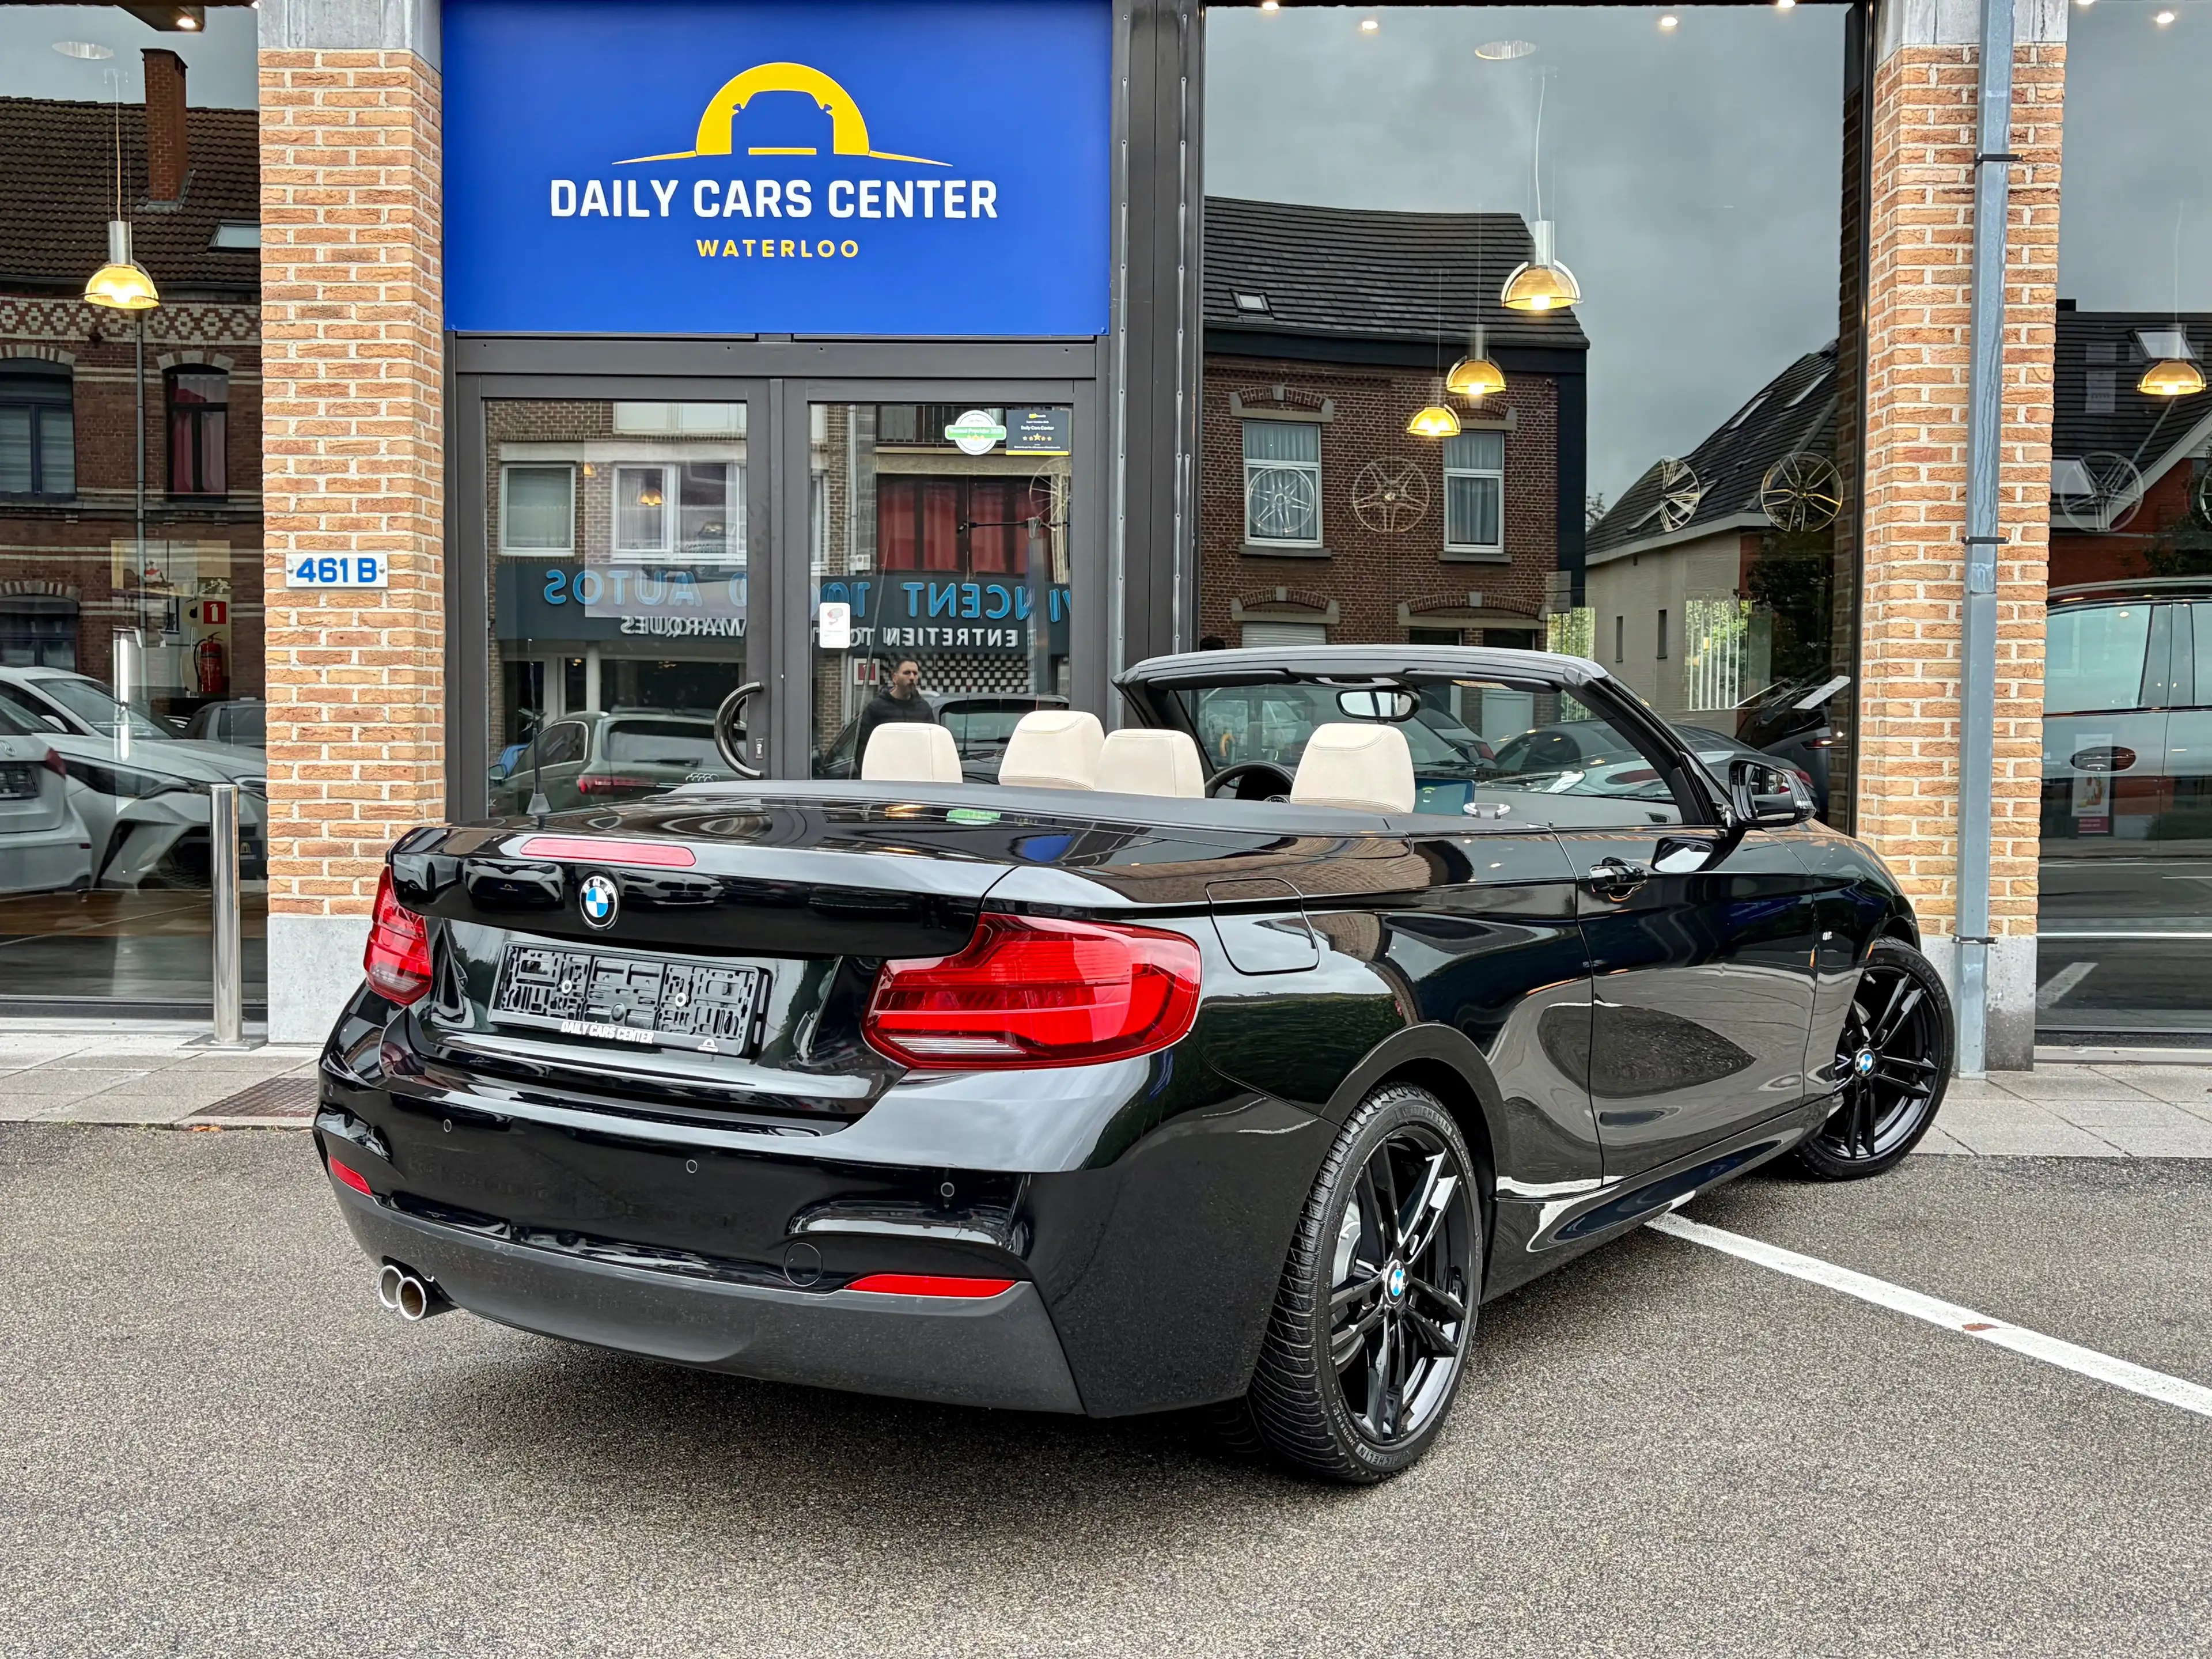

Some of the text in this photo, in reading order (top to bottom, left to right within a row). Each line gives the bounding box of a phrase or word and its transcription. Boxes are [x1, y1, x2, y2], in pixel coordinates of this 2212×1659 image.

[550, 179, 998, 219] DAILY CARS CENTER
[696, 239, 859, 258] WATERLOO
[296, 557, 377, 583] 461 B
[560, 1020, 654, 1044] DAILY CARS CENTER
